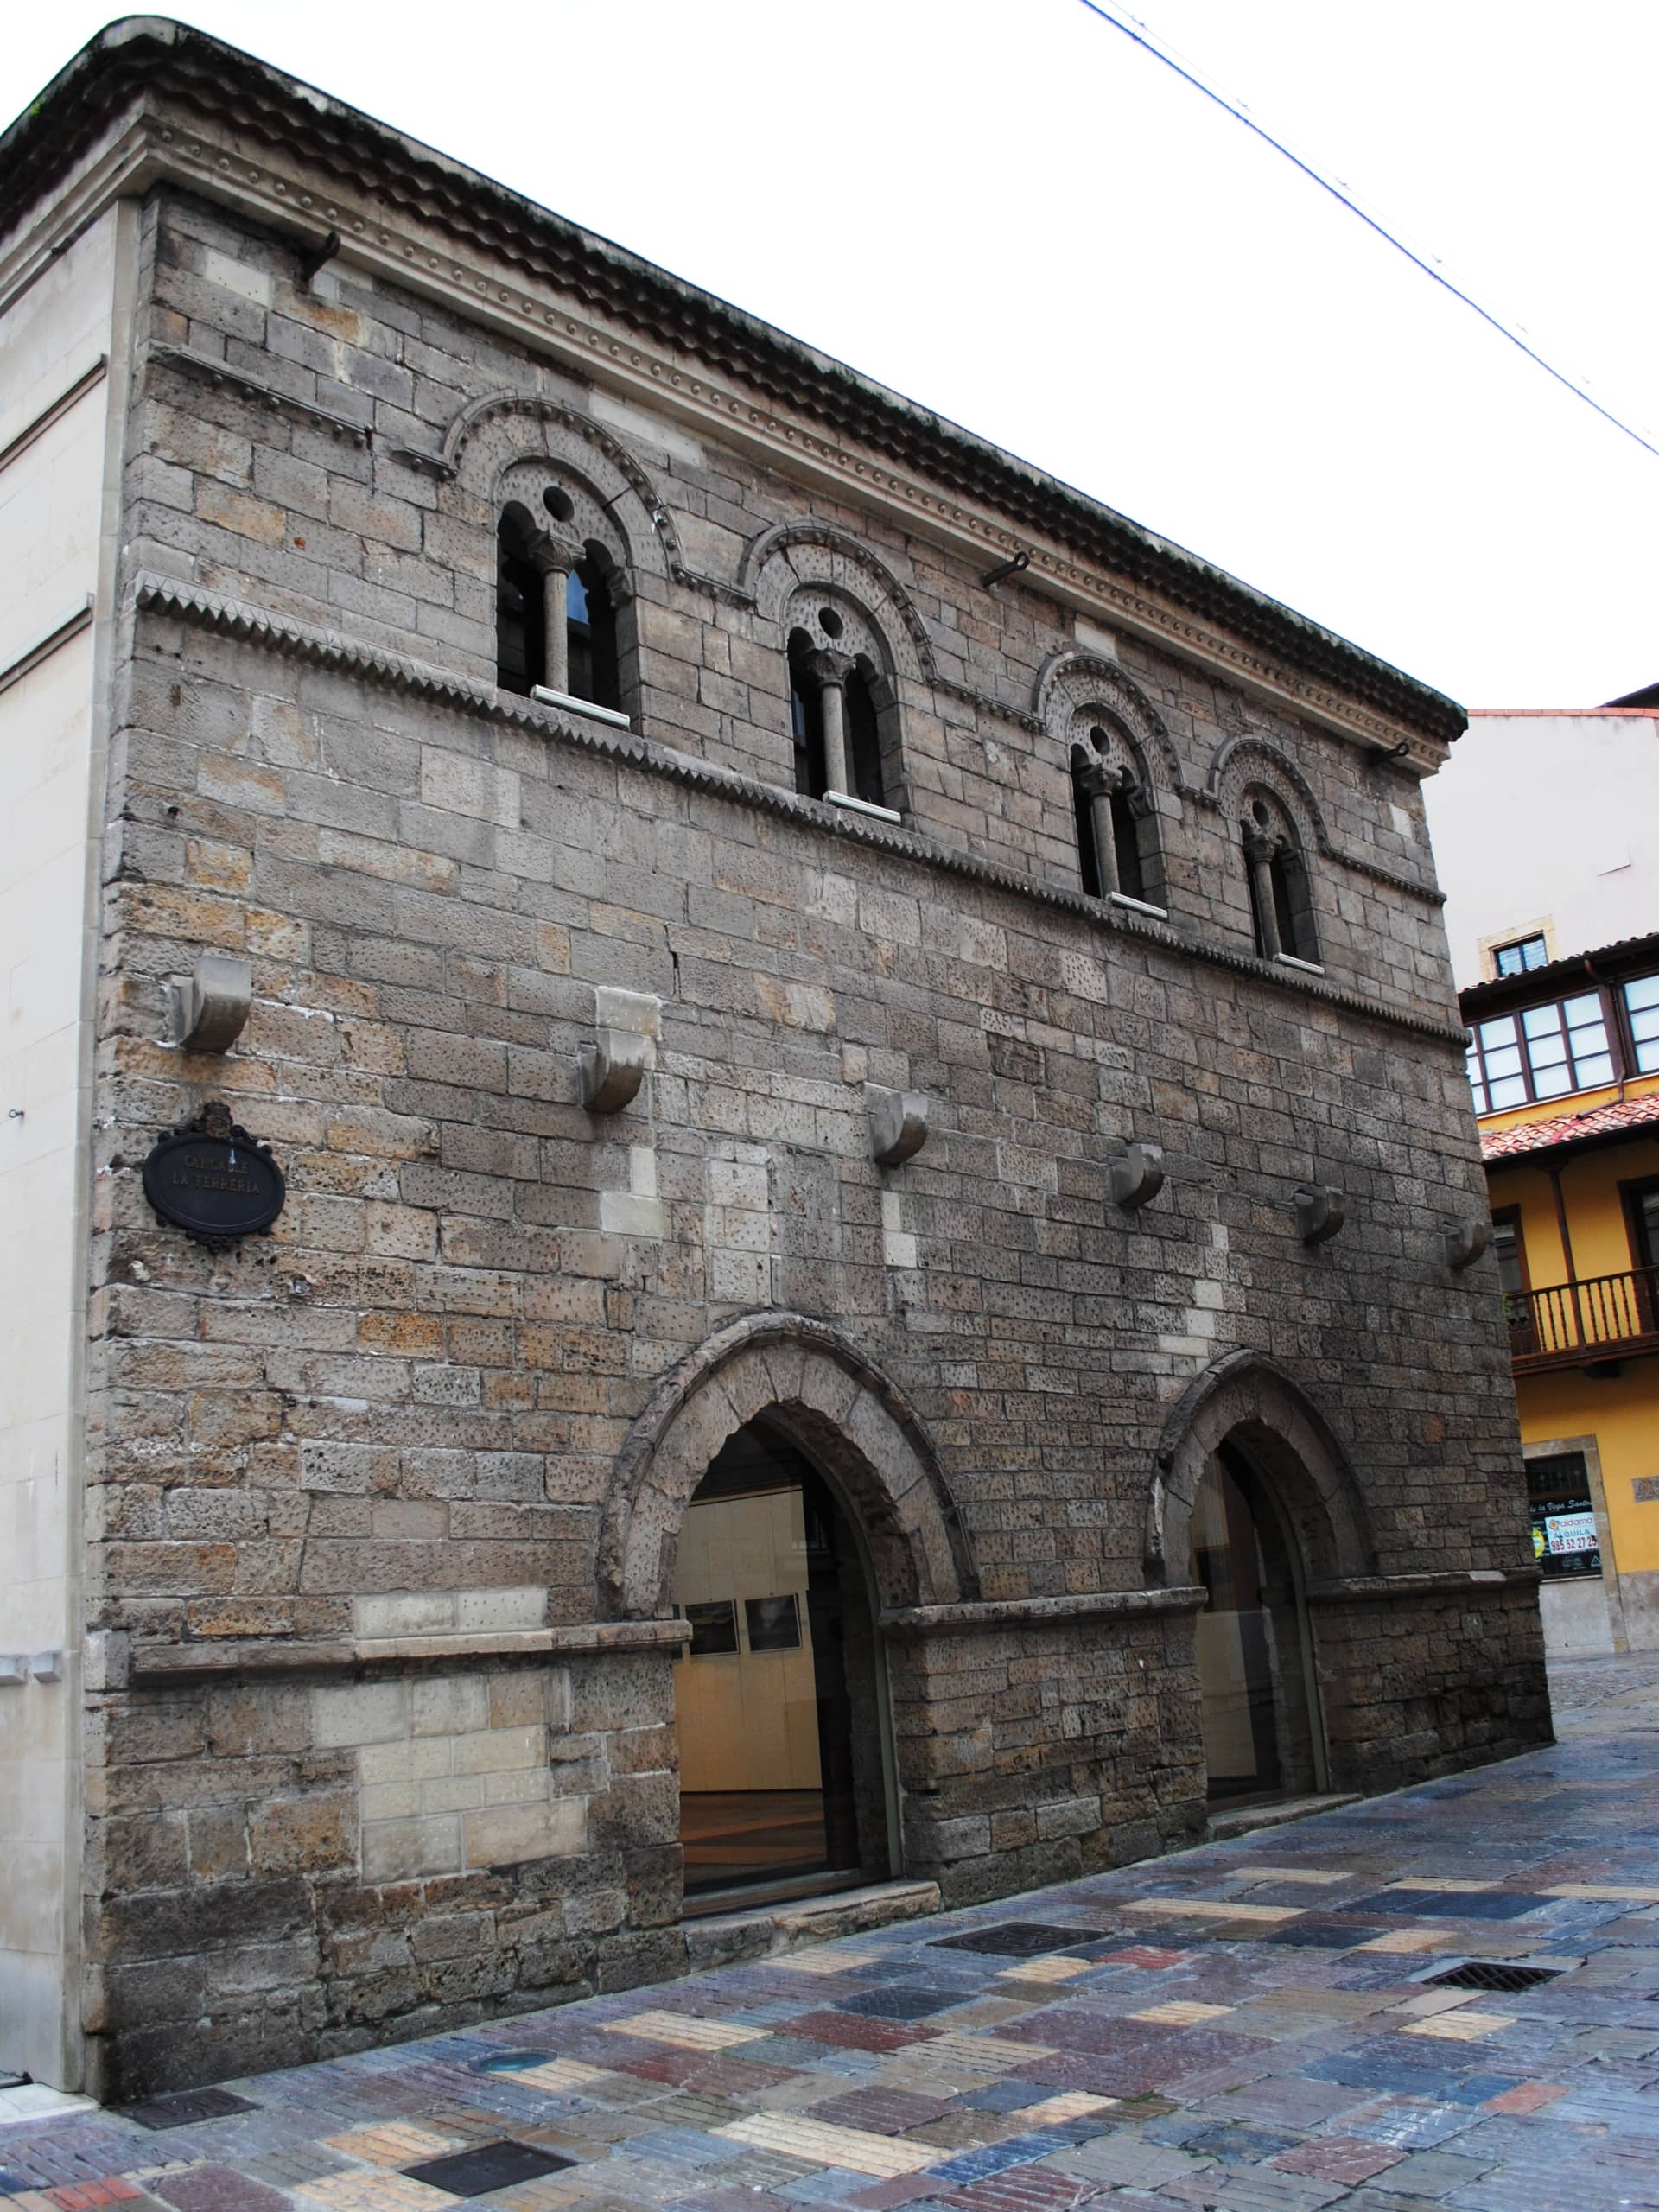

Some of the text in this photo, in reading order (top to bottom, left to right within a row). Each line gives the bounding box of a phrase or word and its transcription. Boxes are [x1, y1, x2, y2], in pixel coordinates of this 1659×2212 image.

[173, 1171, 188, 1185] LA
[1554, 1529, 1591, 1539] ALQUILA
[1551, 1540, 1565, 1552] 985
[1566, 1538, 1575, 1549] 52
[1577, 1536, 1586, 1548] 27
